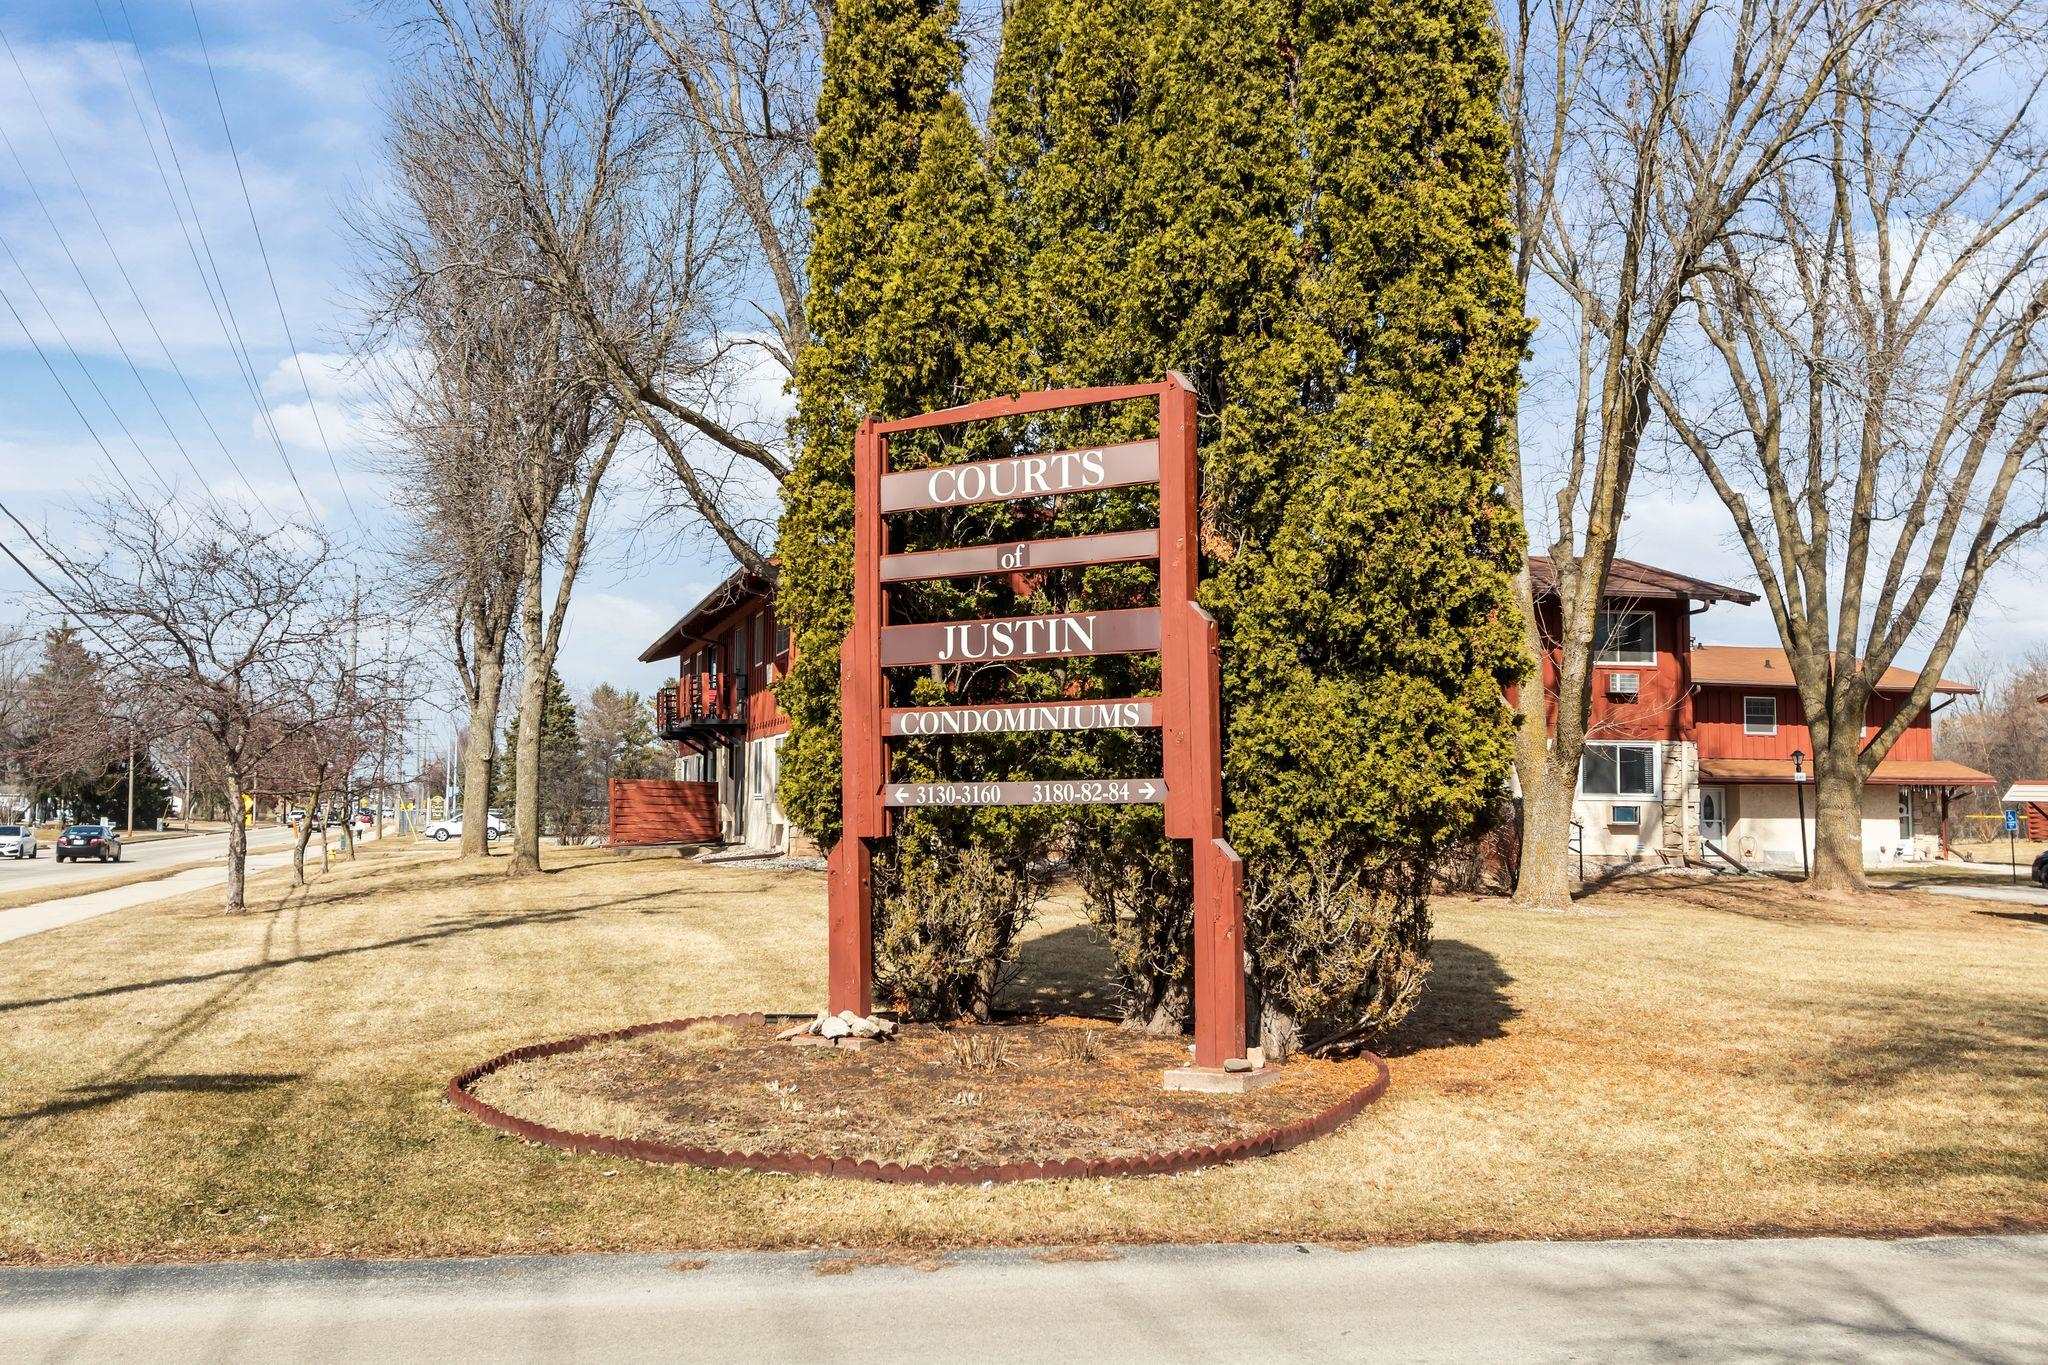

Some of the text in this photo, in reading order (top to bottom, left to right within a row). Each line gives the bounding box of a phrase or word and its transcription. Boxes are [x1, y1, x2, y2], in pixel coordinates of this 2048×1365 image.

[928, 450, 1105, 504] COURTS
[1000, 543, 1026, 569] of
[938, 615, 1097, 661] JUSTIN
[900, 703, 1140, 735] CONDOMINIUMS
[916, 785, 1000, 804] 3130-3160
[1032, 782, 1130, 803] 3180-82-84
